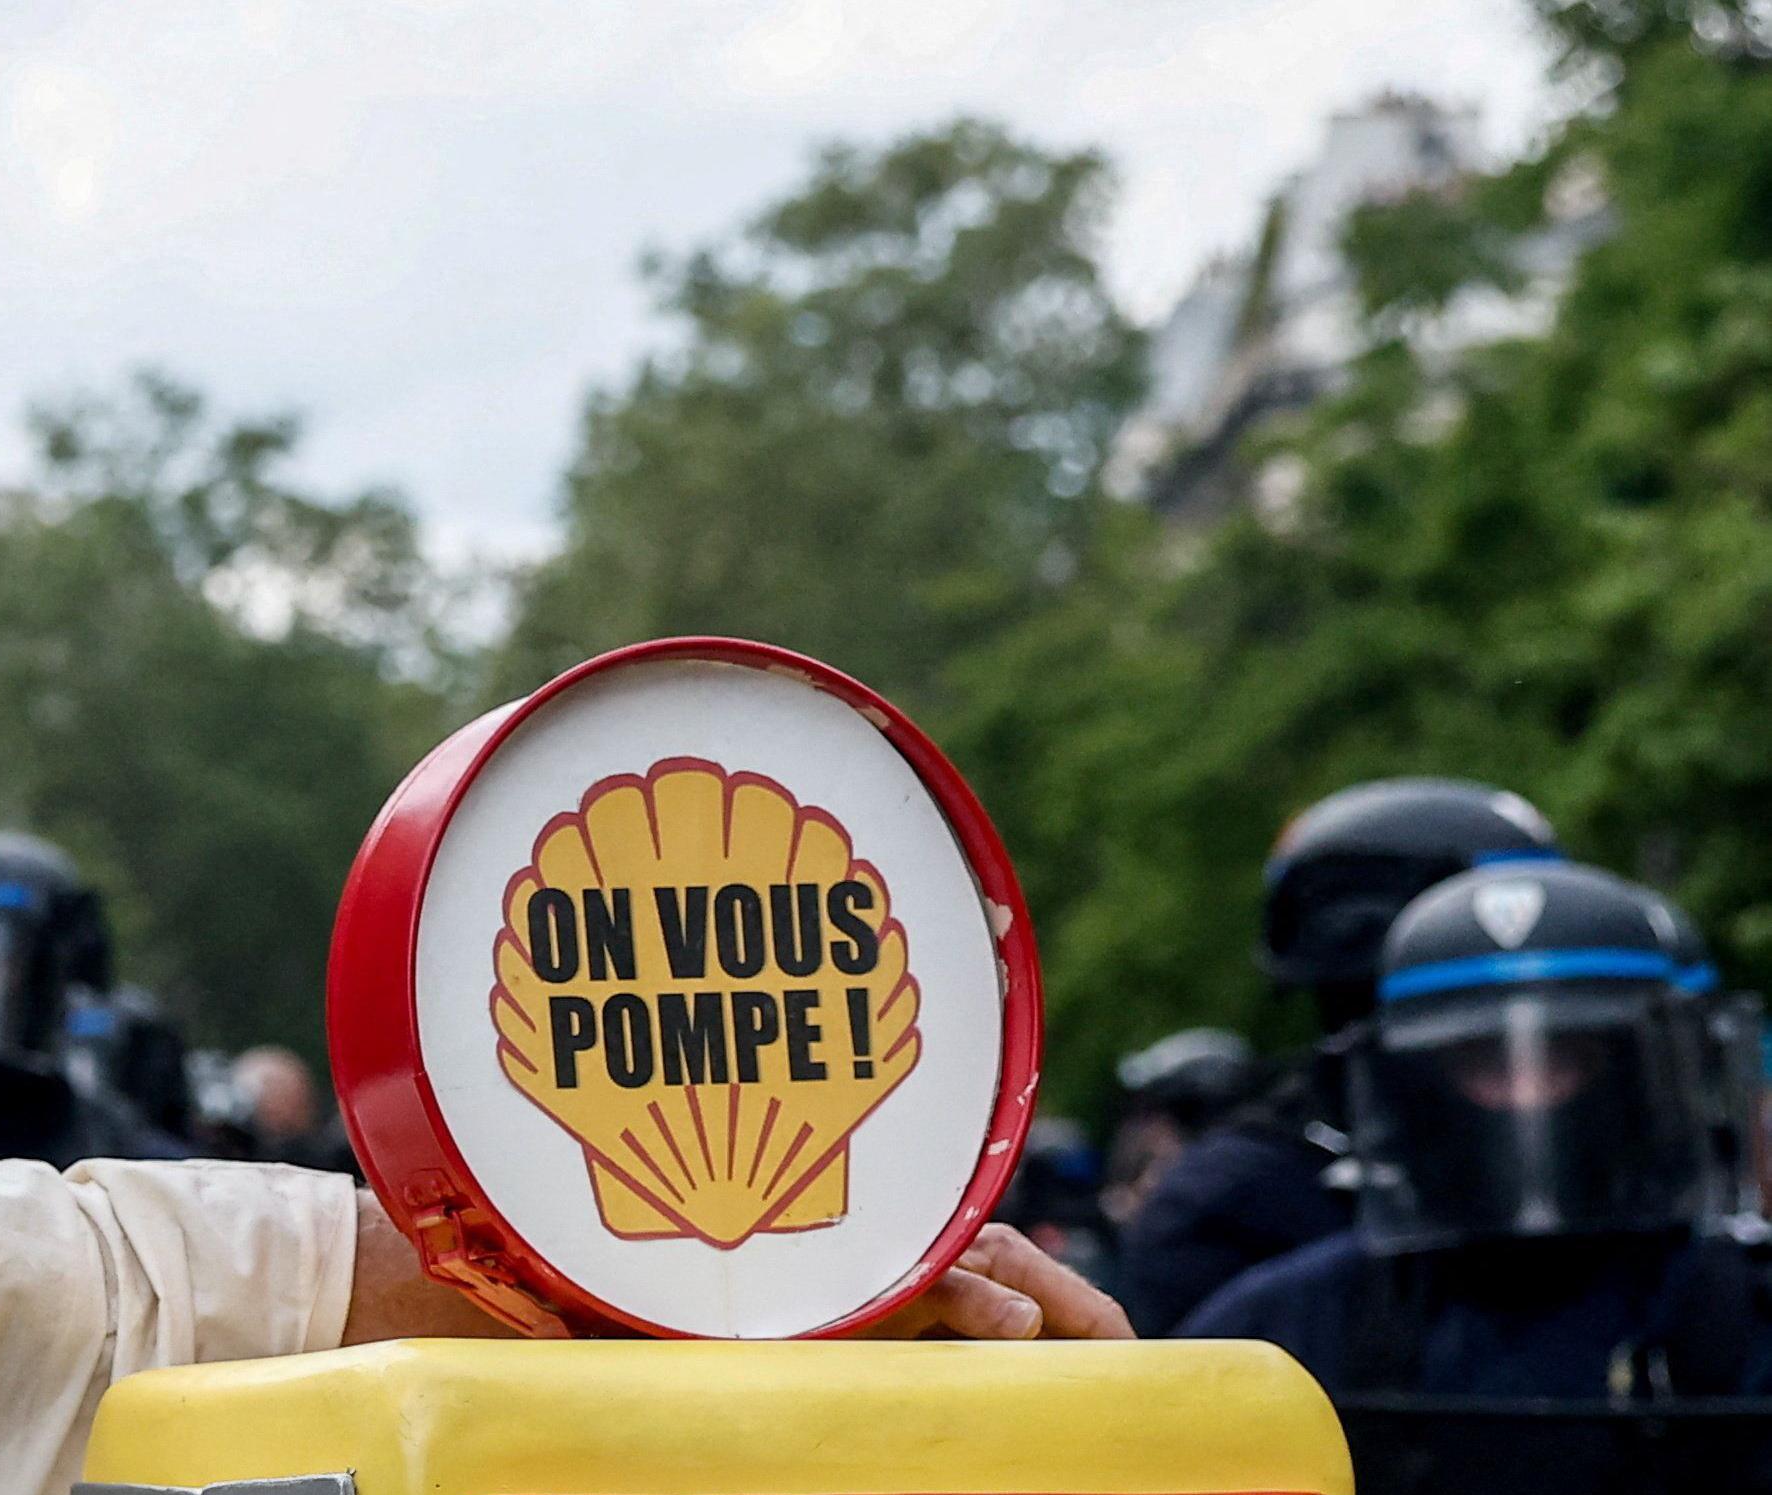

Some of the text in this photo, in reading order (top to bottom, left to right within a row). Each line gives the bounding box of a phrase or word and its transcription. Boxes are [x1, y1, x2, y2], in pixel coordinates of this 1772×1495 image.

[527, 880, 879, 983] ON VOUS
[548, 987, 875, 1090] POMPE !
